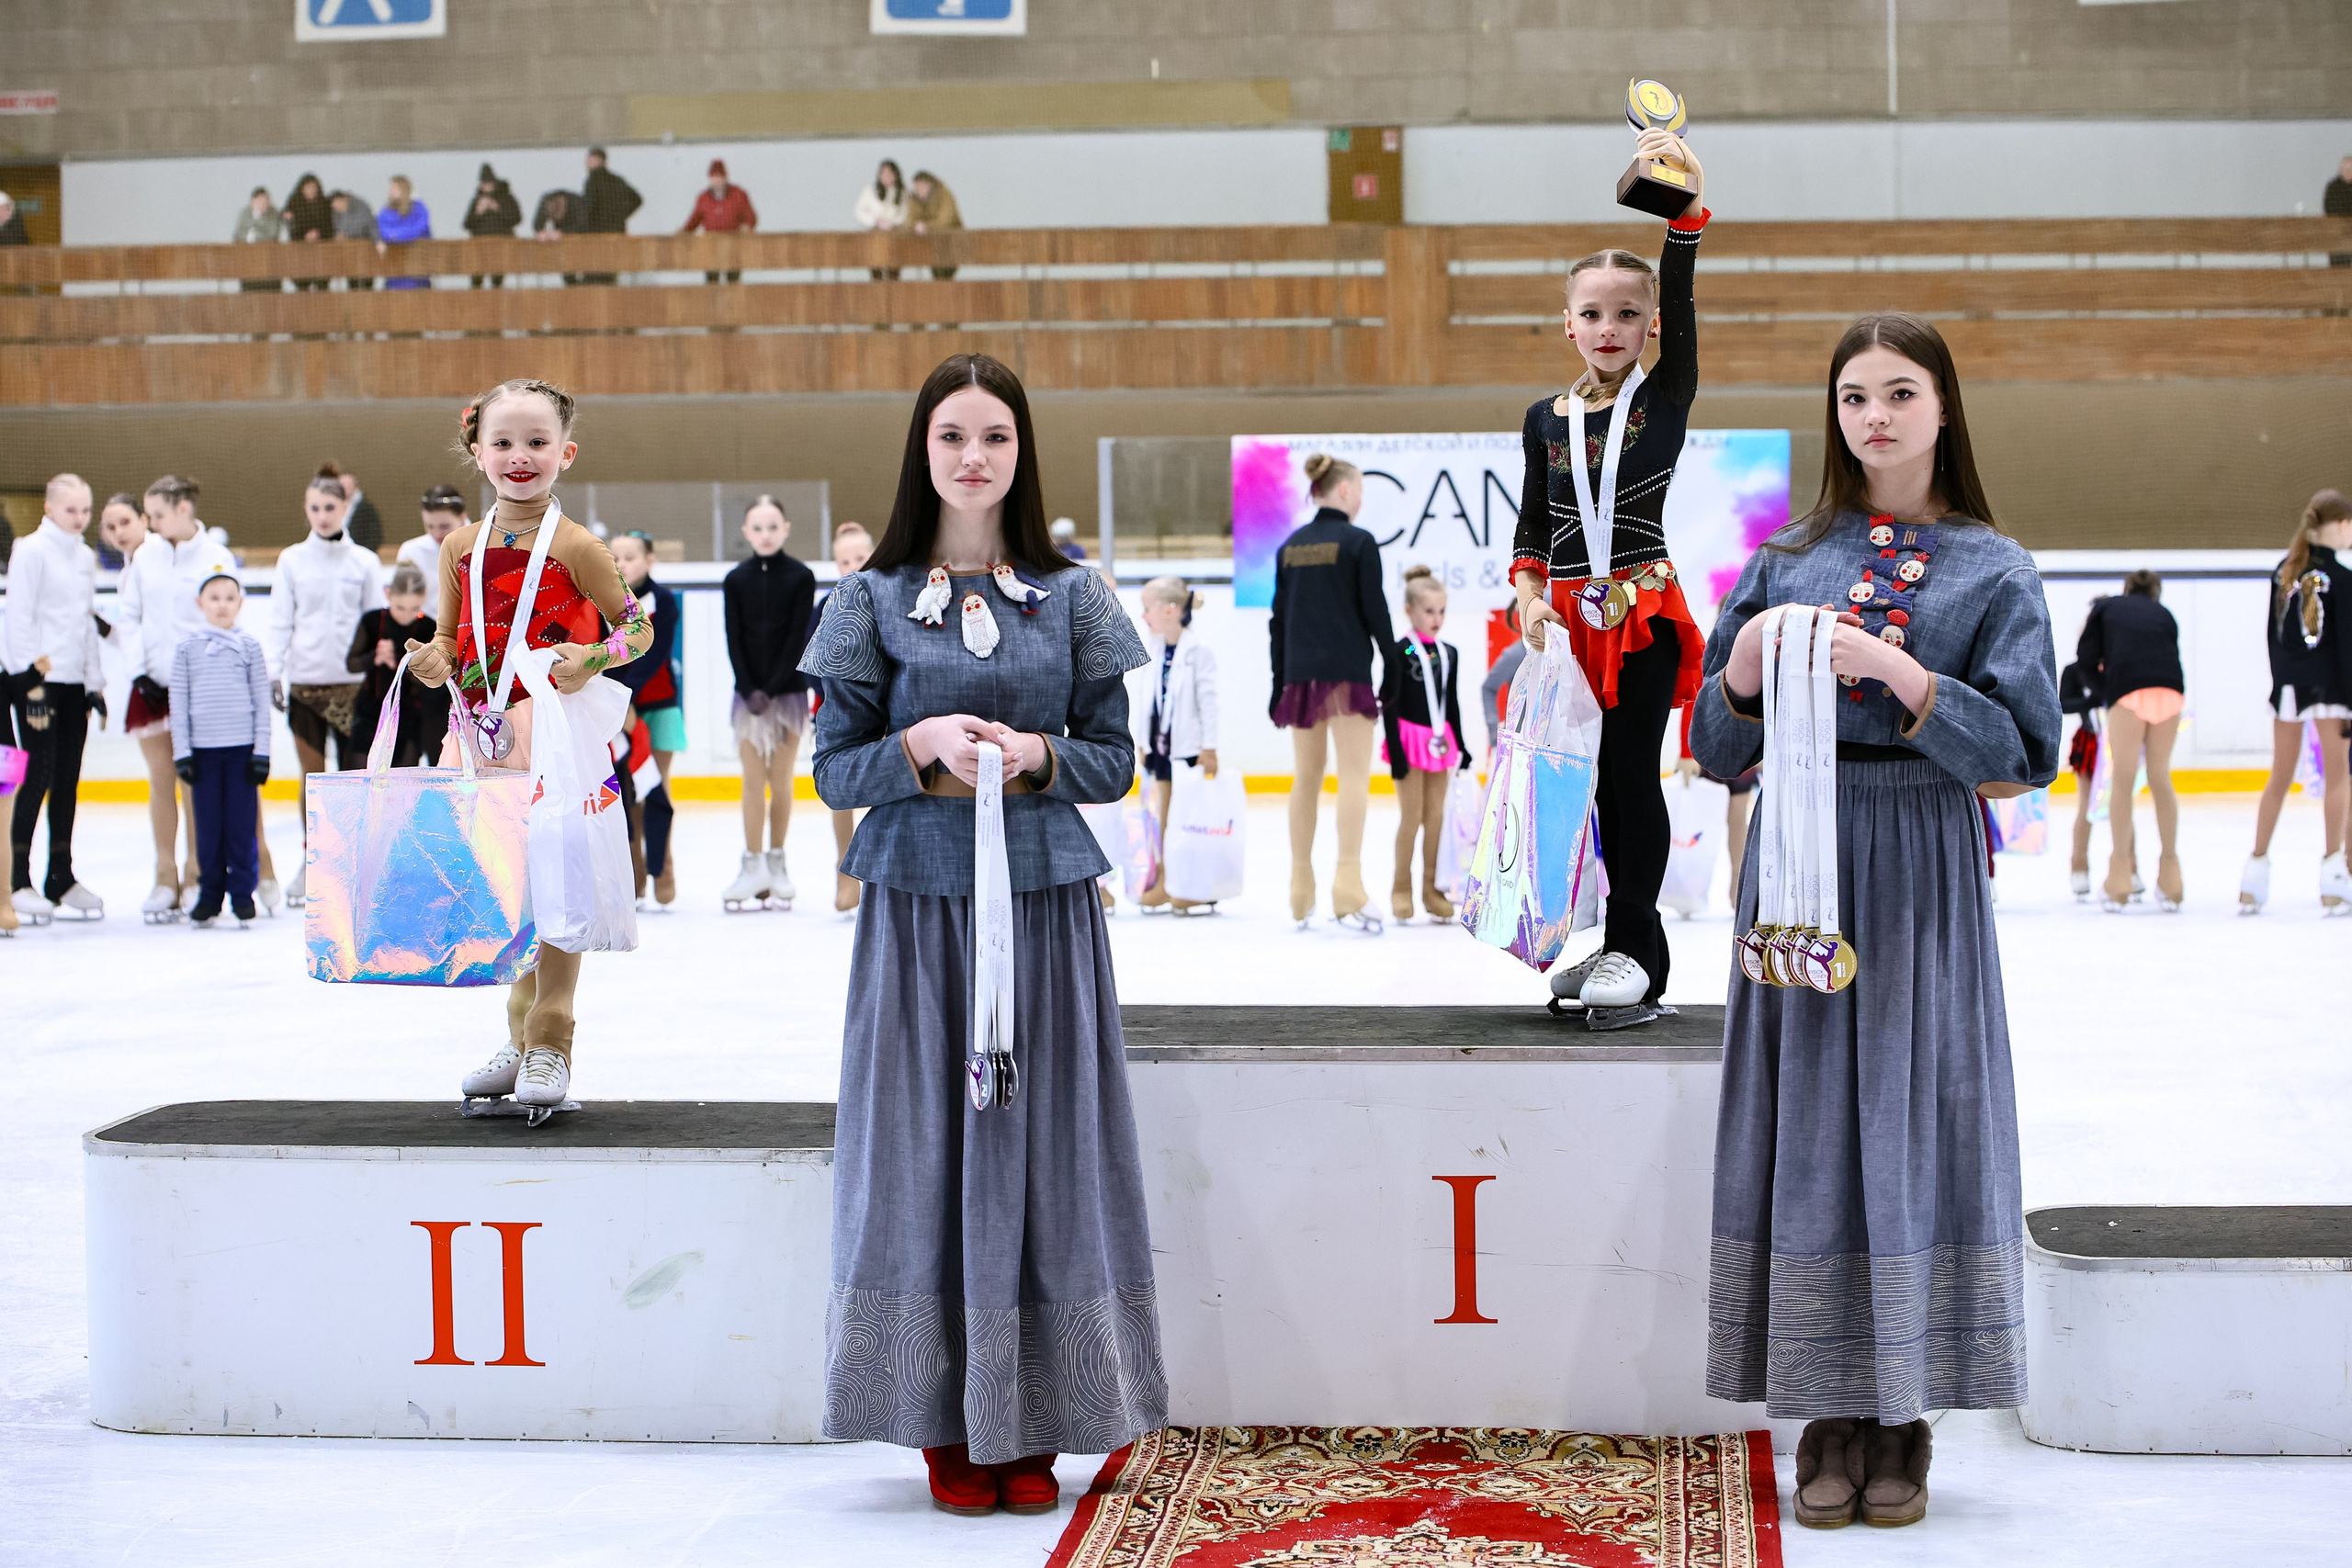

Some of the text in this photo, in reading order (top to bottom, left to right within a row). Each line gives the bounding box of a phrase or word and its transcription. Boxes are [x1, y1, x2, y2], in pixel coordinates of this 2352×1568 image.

[1377, 435, 1463, 452] ДЕТСКОЙ
[1600, 479, 1609, 501] CANDY
[1607, 478, 1615, 502] КУБОК
[1477, 559, 1502, 590] &
[1607, 603, 1614, 616] 1
[497, 739, 505, 750] 2
[1834, 962, 1841, 978] 1
[1431, 1175, 1498, 1325] I
[410, 1221, 547, 1367] II
